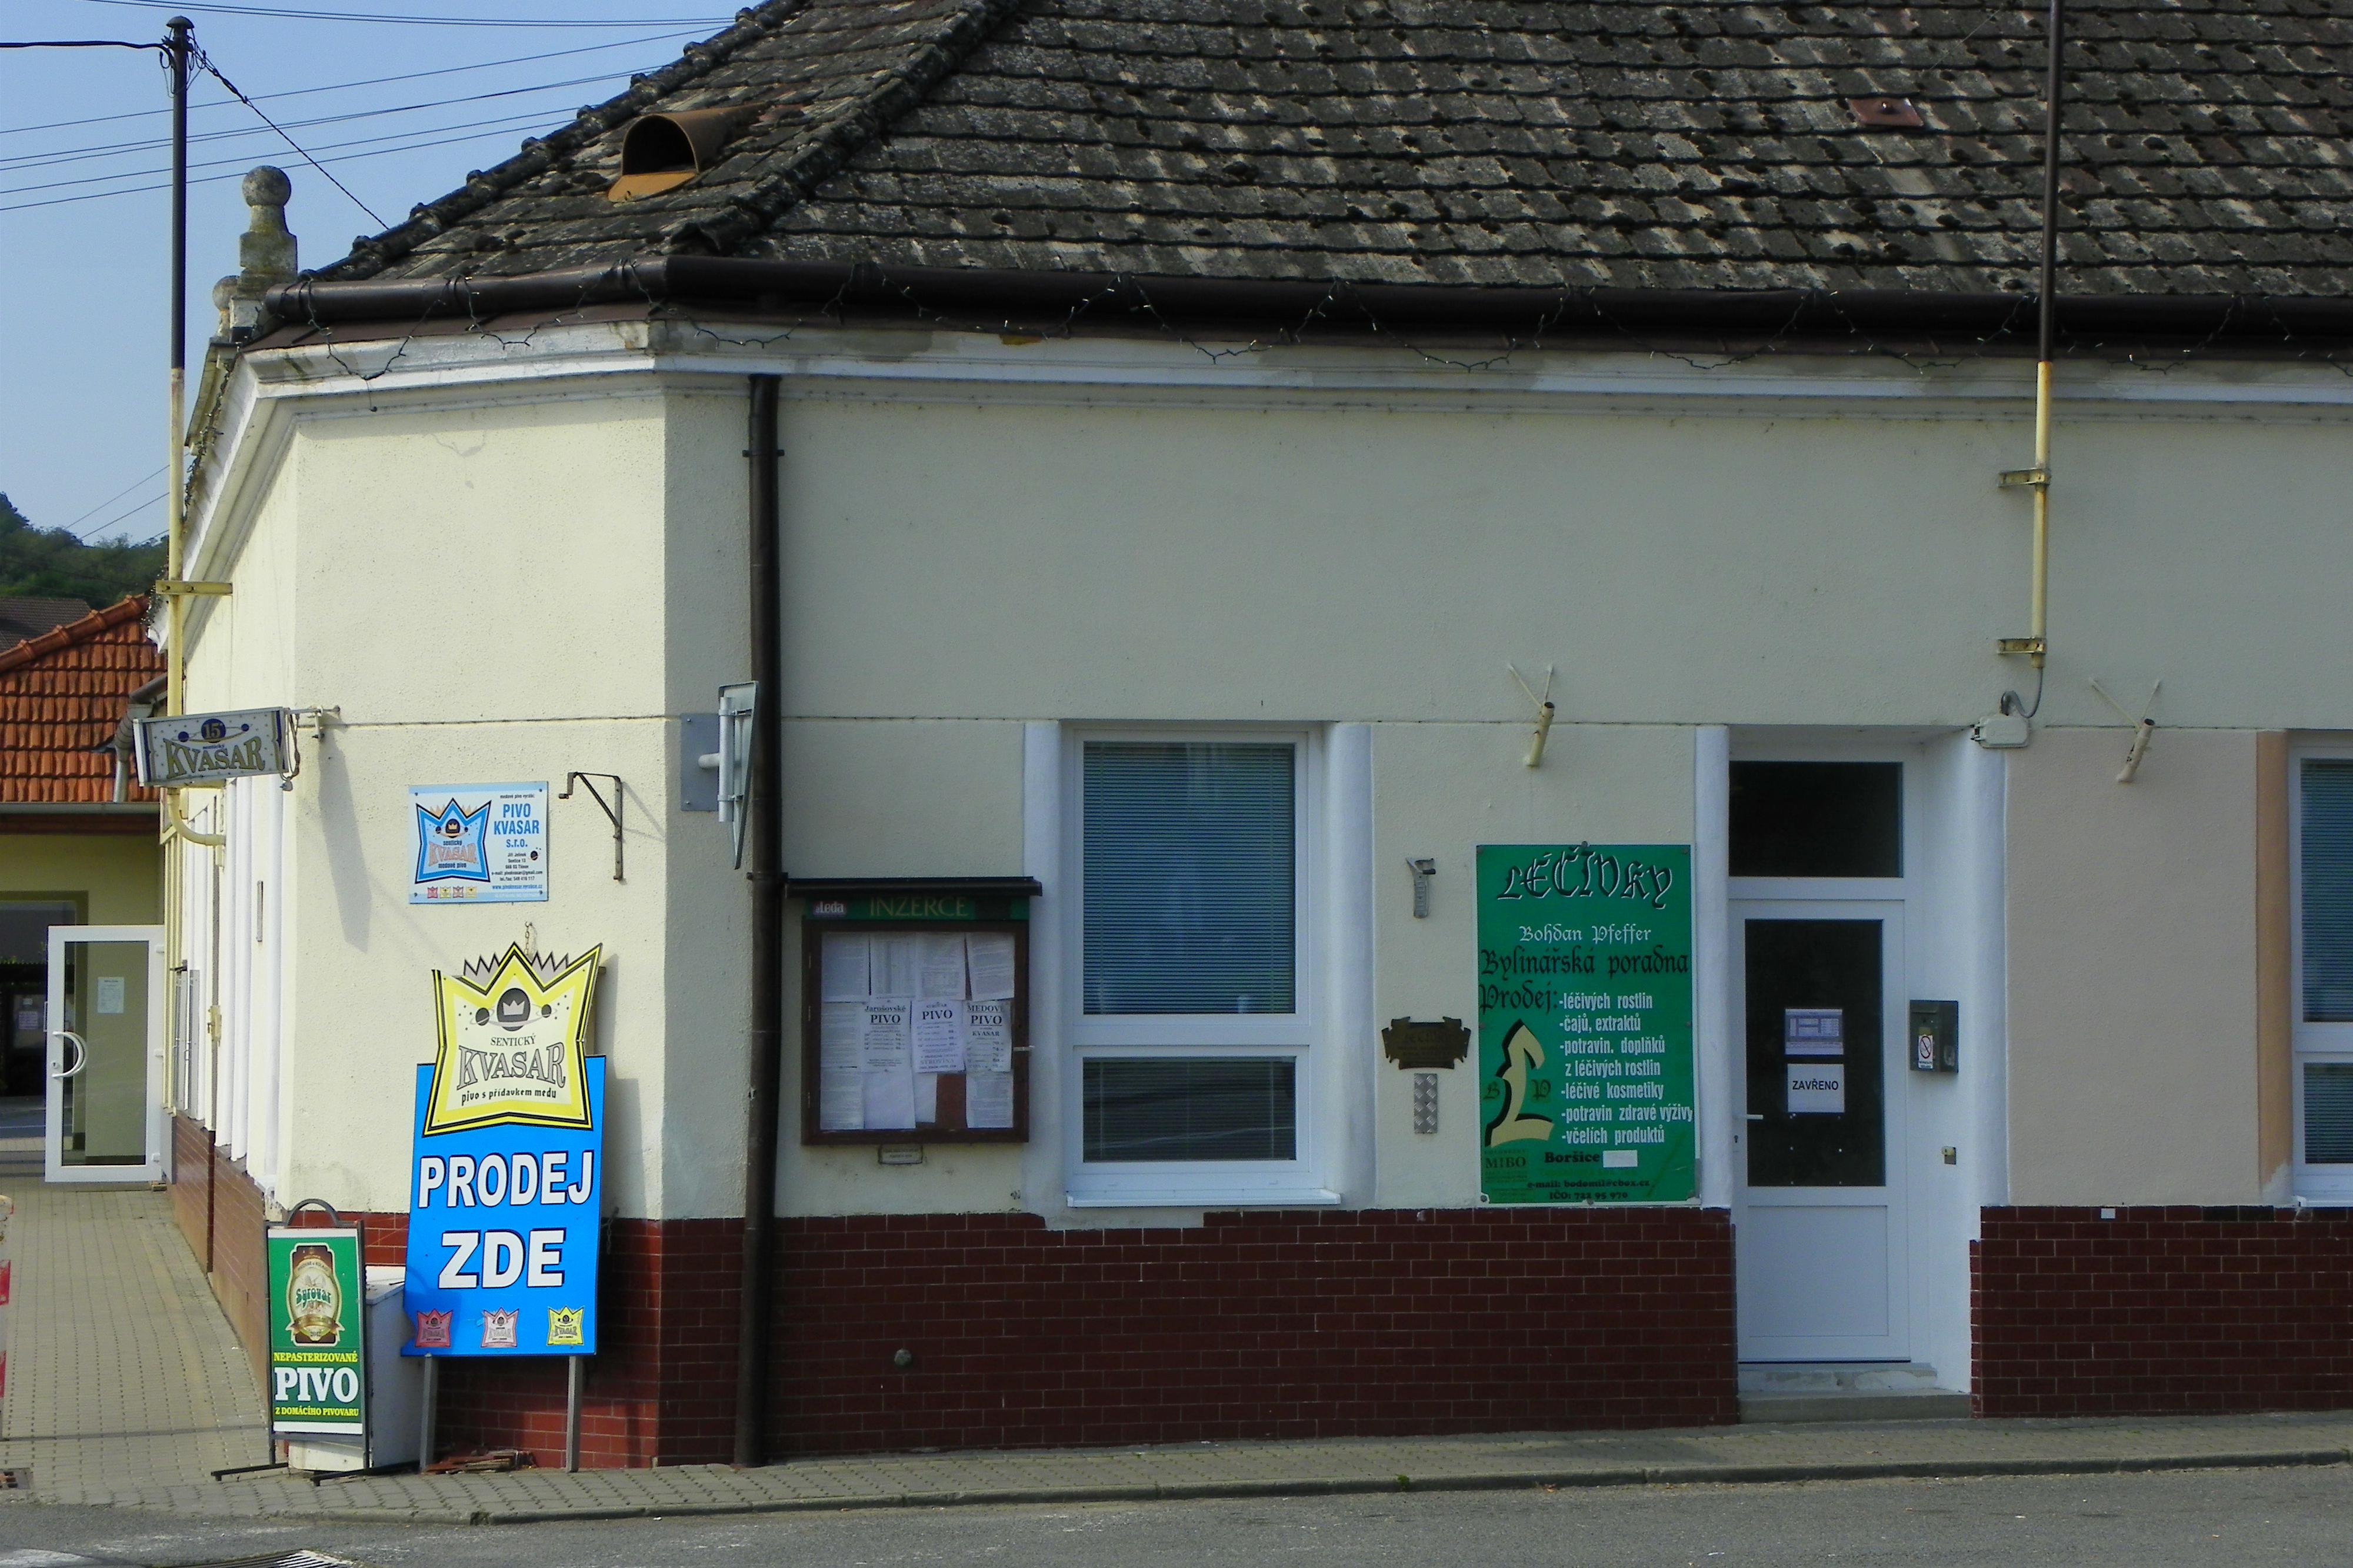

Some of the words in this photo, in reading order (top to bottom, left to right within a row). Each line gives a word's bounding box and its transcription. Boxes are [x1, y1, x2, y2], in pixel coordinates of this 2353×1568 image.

[163, 736, 265, 779] KVASAR
[503, 803, 531, 818] PIVO
[494, 820, 539, 835] KVASAR
[506, 839, 528, 848] s.r.o.
[429, 842, 478, 866] KVASAR
[869, 897, 969, 917] INZERCE
[1519, 924, 1582, 944] Bohdan
[1592, 924, 1651, 945] Pfeffer
[1481, 945, 1595, 980] Bylinářská
[1608, 945, 1688, 979] poradna
[1479, 980, 1558, 1014] Prodej:
[1559, 992, 1610, 1012] -léčivých
[1617, 992, 1653, 1009] rostlin
[871, 1015, 901, 1023] PIVO
[922, 1009, 953, 1020] PIVO
[971, 1015, 1002, 1025] PIVO
[1559, 1013, 1592, 1032] -čajů,
[1595, 1013, 1641, 1031] extraktů
[490, 1033, 538, 1046] SENTICKÝ
[1559, 1037, 1614, 1056] -potravin.
[1621, 1035, 1665, 1056] doplňků
[456, 1042, 566, 1091] KVASAR
[1565, 1065, 1571, 1076] z
[1575, 1060, 1622, 1079] léčivých
[1625, 1060, 1661, 1076] rostlin
[1561, 1082, 1600, 1099] -léčivé
[1607, 1081, 1664, 1100] kosmetiky
[1792, 1078, 1839, 1090] ZAVŘENO
[462, 1090, 480, 1106] pivo
[489, 1087, 532, 1100] přídavkem
[534, 1088, 556, 1099] medu
[1561, 1106, 1612, 1124] -potravin
[1619, 1104, 1657, 1121] zdravé
[1660, 1103, 1693, 1123] výživy
[1561, 1127, 1608, 1145] -včelích
[1614, 1125, 1665, 1146] produktů
[1544, 1150, 1600, 1163] Boršice
[418, 1149, 595, 1209] PRODEJ
[1549, 1190, 1571, 1200] IČO:
[1595, 1192, 1607, 1200] 95
[1609, 1191, 1628, 1199] 970
[438, 1227, 567, 1289] ZDE
[296, 1288, 331, 1309] Syrovar
[274, 1350, 358, 1363] NEPASTERIZOVANÉ
[274, 1366, 359, 1403] PIVO
[282, 1405, 322, 1416] DOMÁCÍHO
[322, 1408, 359, 1417] PIVOVARU
